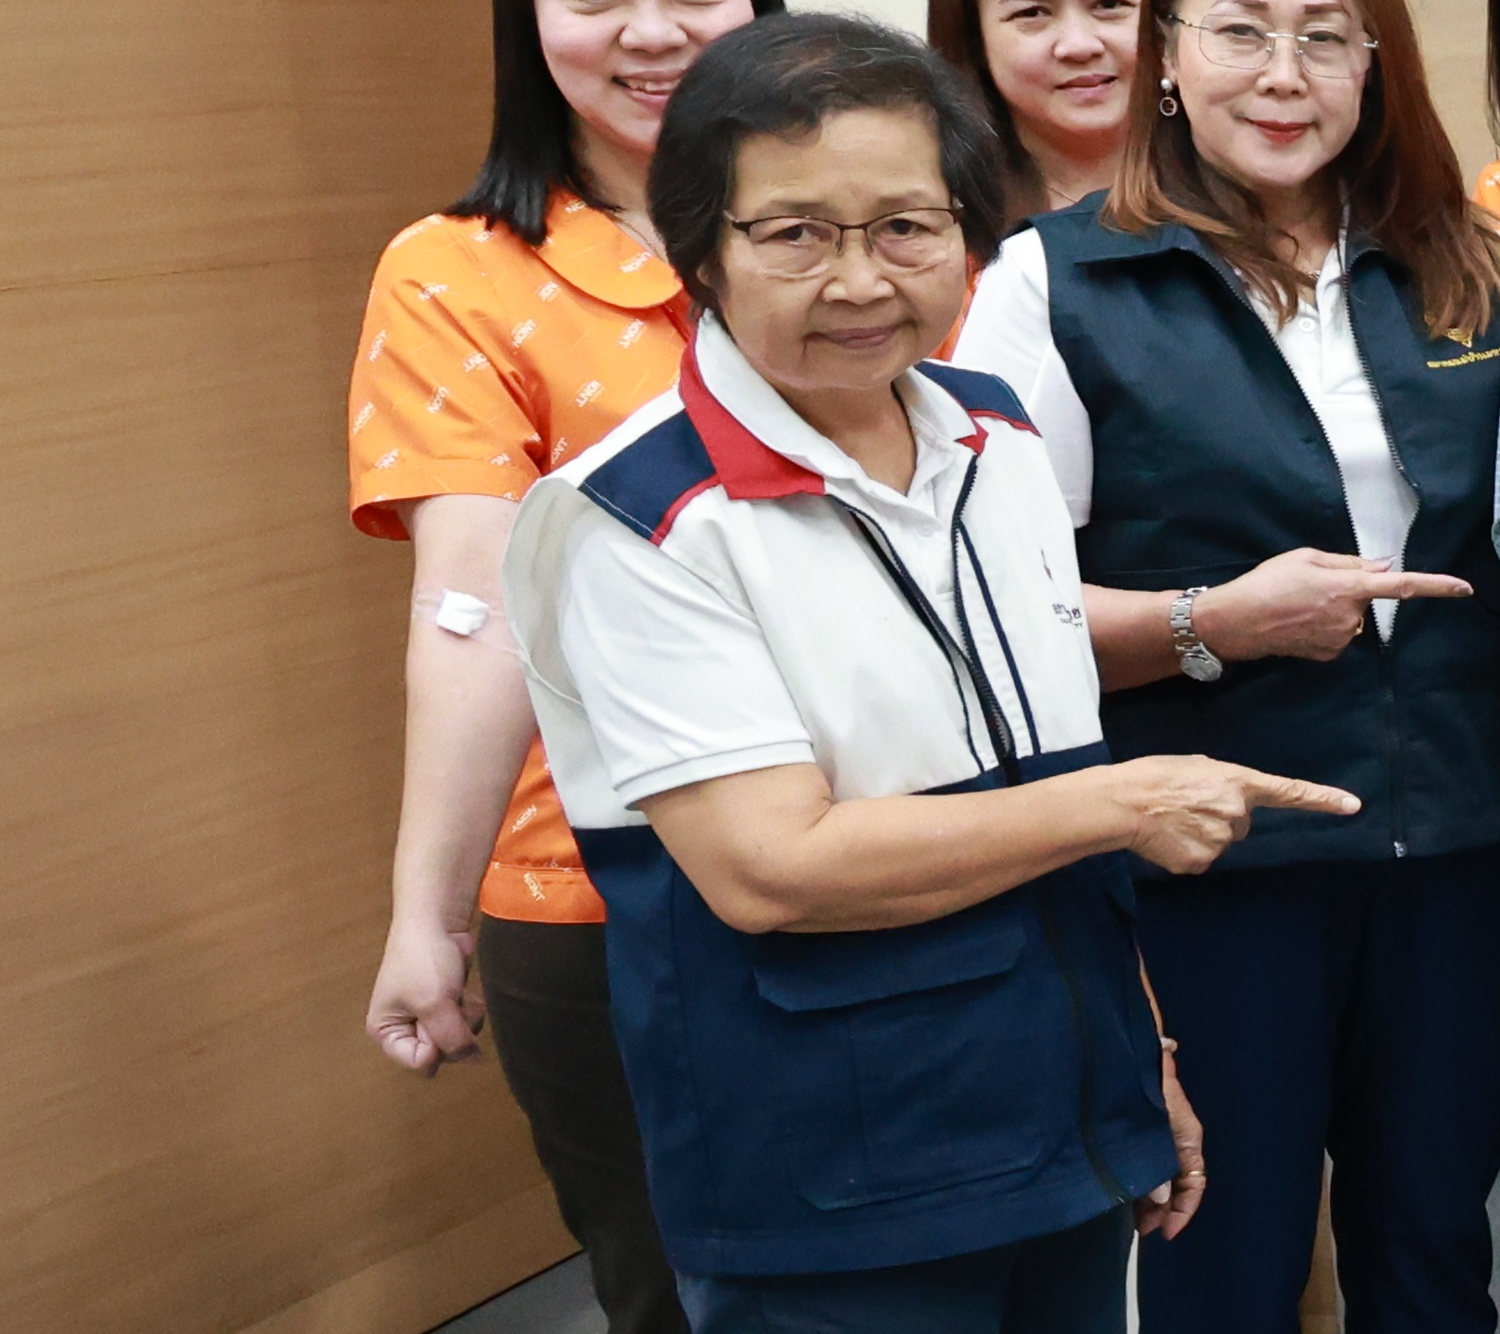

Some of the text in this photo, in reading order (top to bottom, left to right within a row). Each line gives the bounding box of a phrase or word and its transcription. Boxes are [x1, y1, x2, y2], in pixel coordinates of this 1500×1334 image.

[513, 319, 537, 348] NONT
[618, 319, 645, 350] NONT
[575, 379, 602, 408] NONT
[523, 872, 545, 901] NONT
